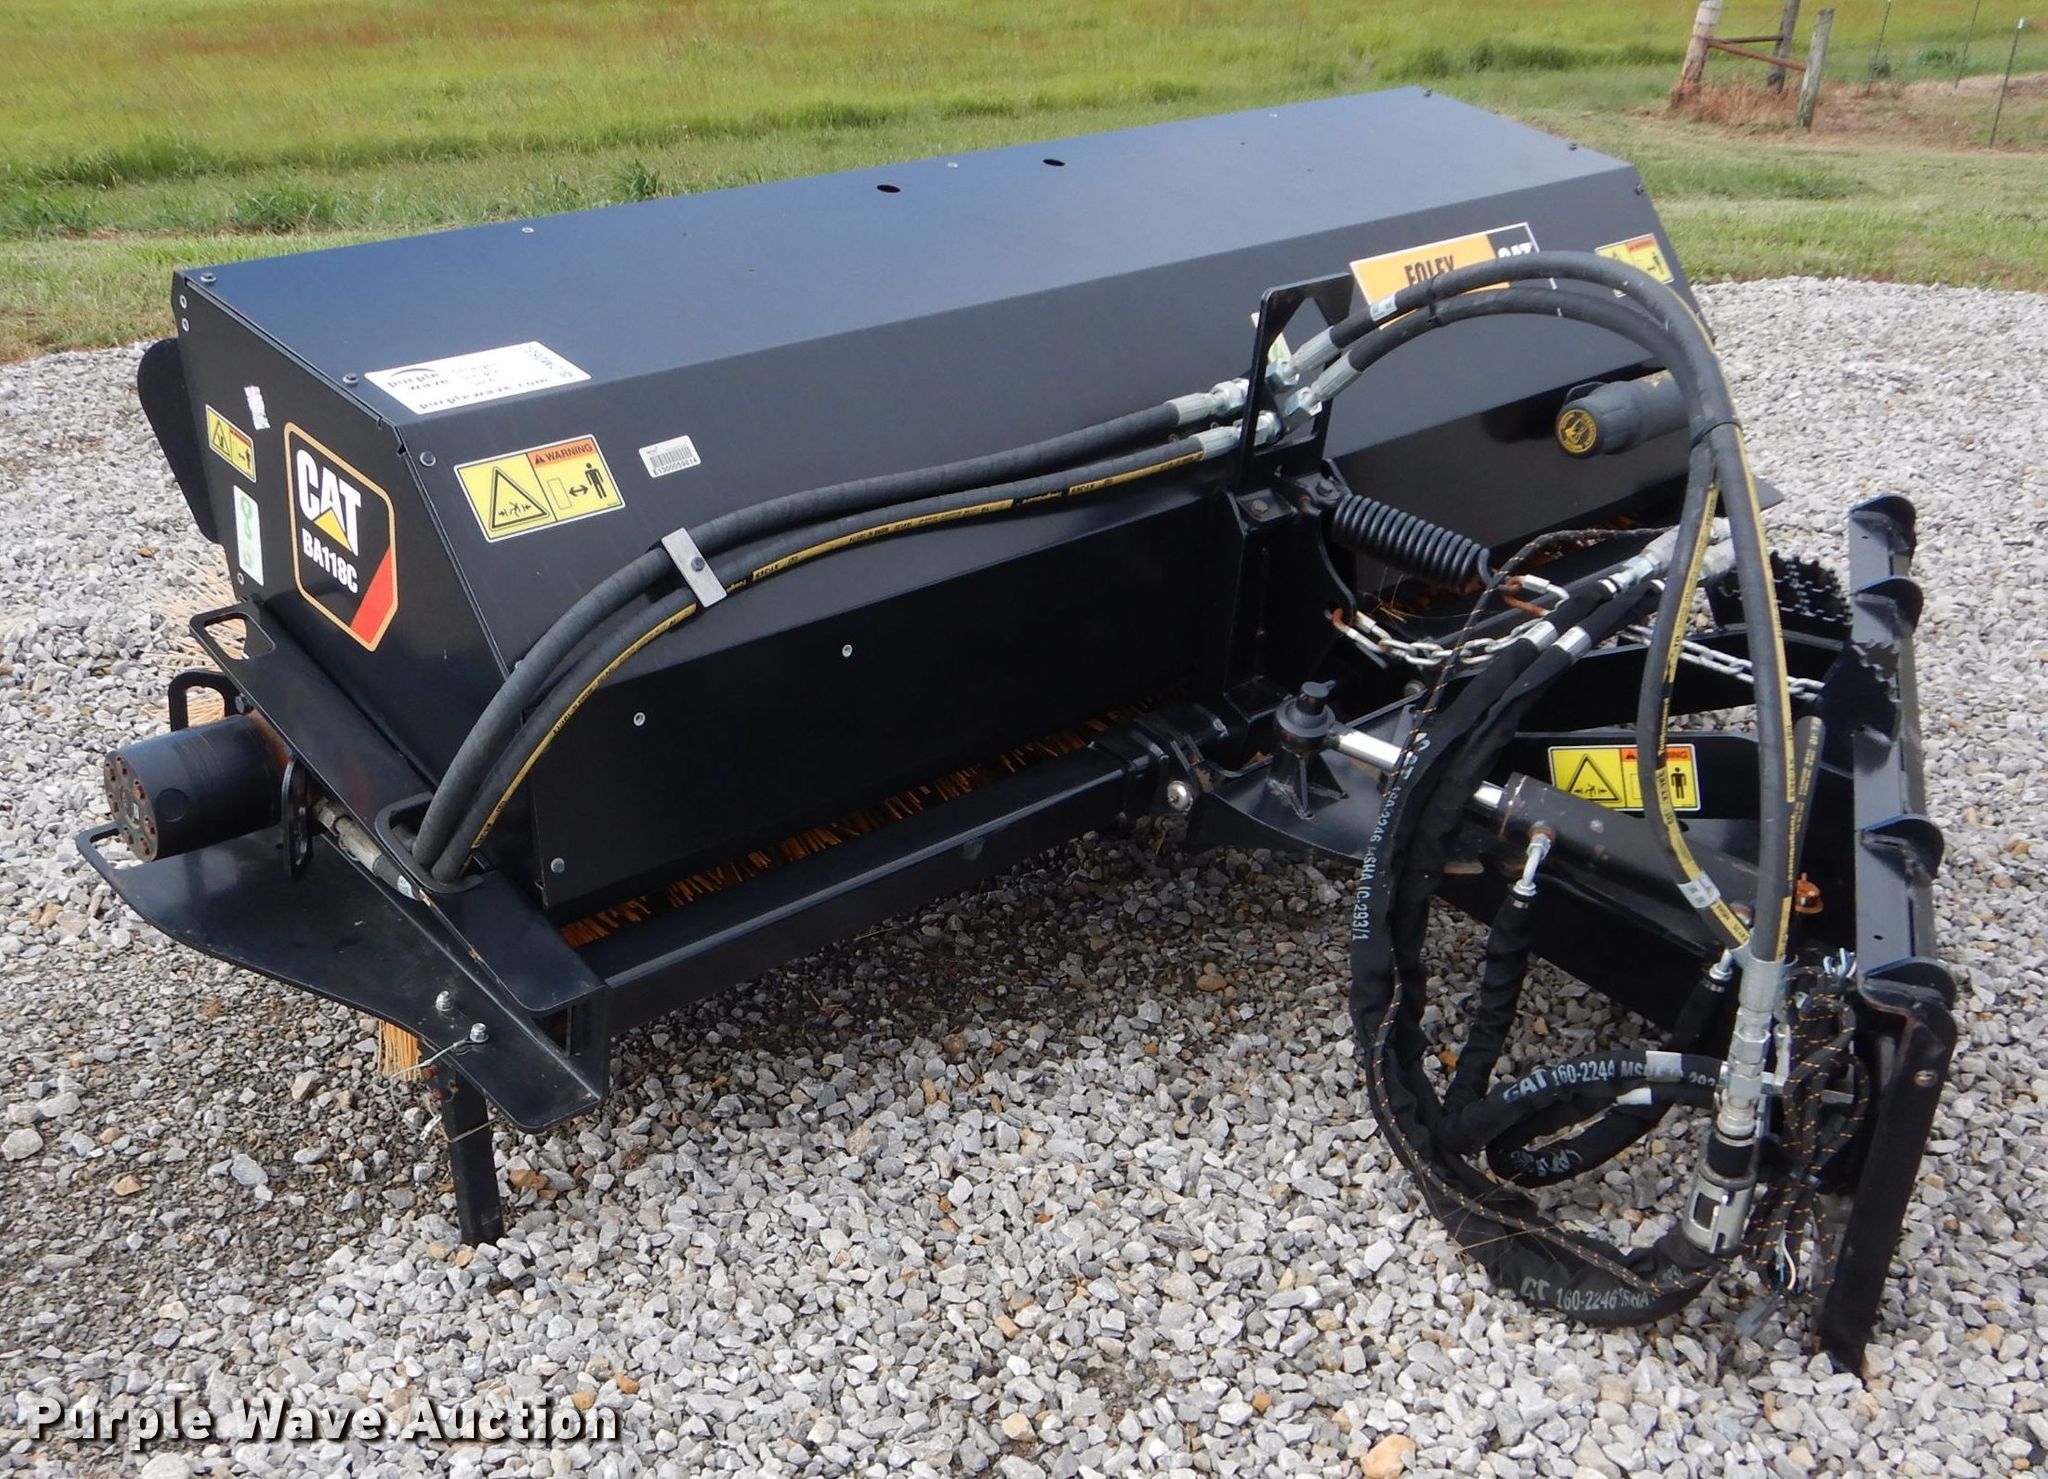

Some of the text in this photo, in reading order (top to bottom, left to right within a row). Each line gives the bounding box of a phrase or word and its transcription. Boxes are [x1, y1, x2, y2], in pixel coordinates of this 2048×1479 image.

[546, 443, 594, 462] WARNING
[296, 449, 361, 556] CAT
[302, 528, 358, 594] BA118C
